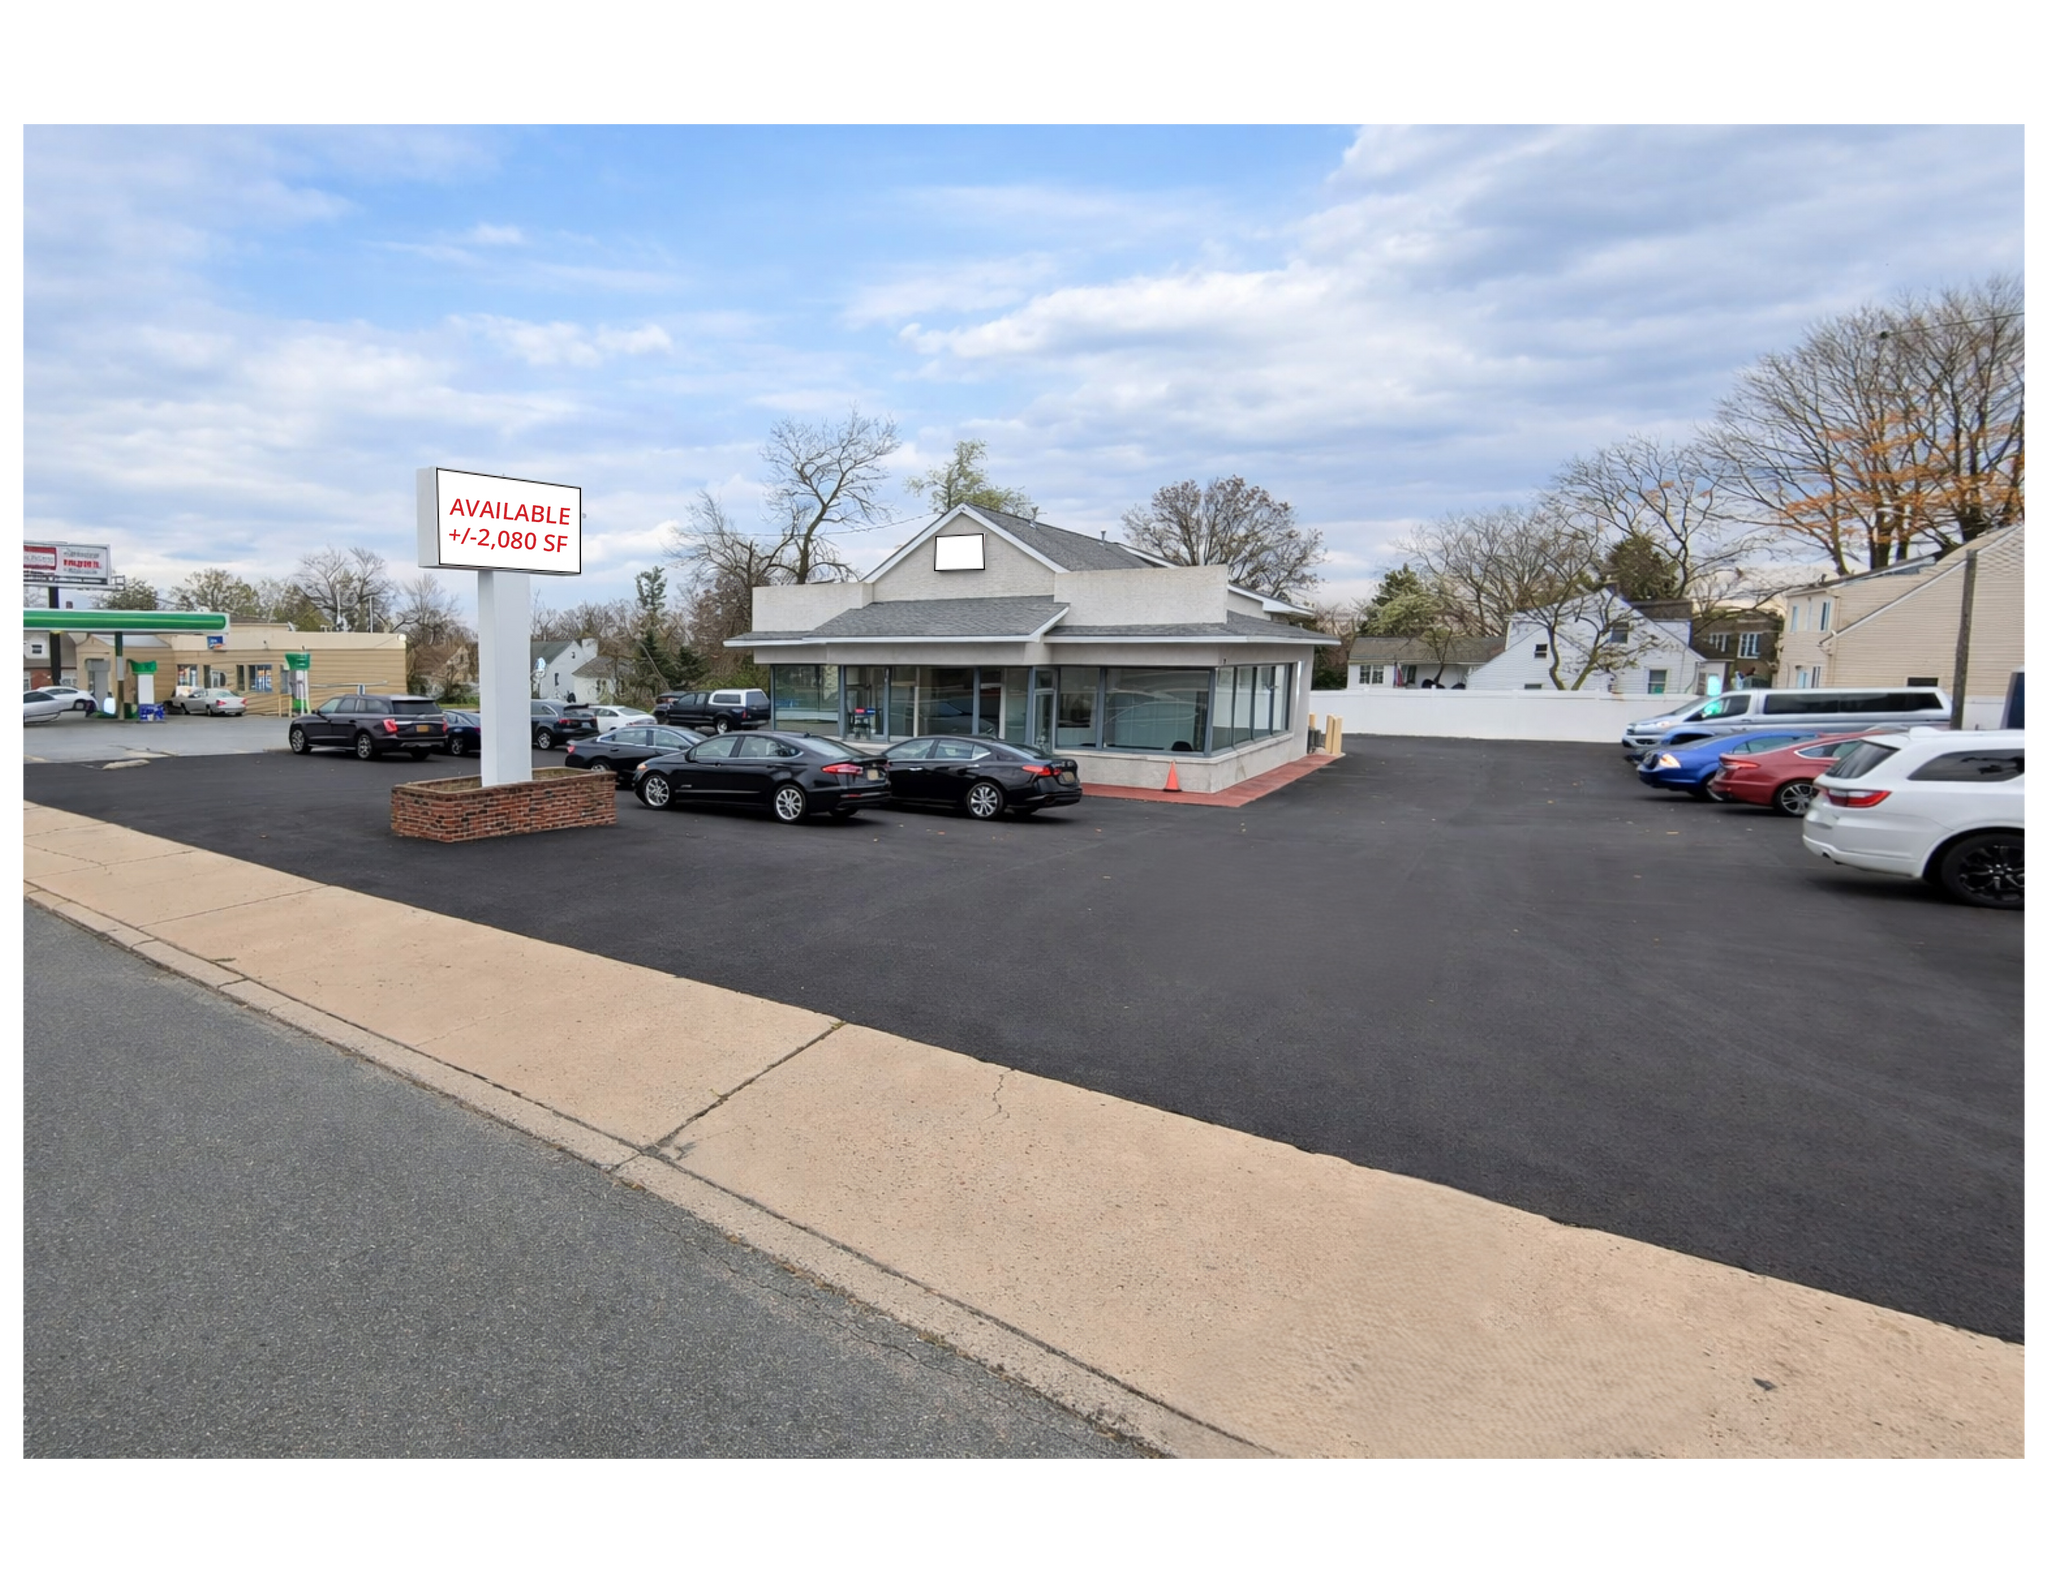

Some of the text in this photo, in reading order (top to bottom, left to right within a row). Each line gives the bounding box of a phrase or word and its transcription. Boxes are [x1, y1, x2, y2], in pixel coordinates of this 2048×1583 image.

[449, 498, 571, 526] AVAILABLE
[448, 527, 569, 553] +/-2,080 SF
